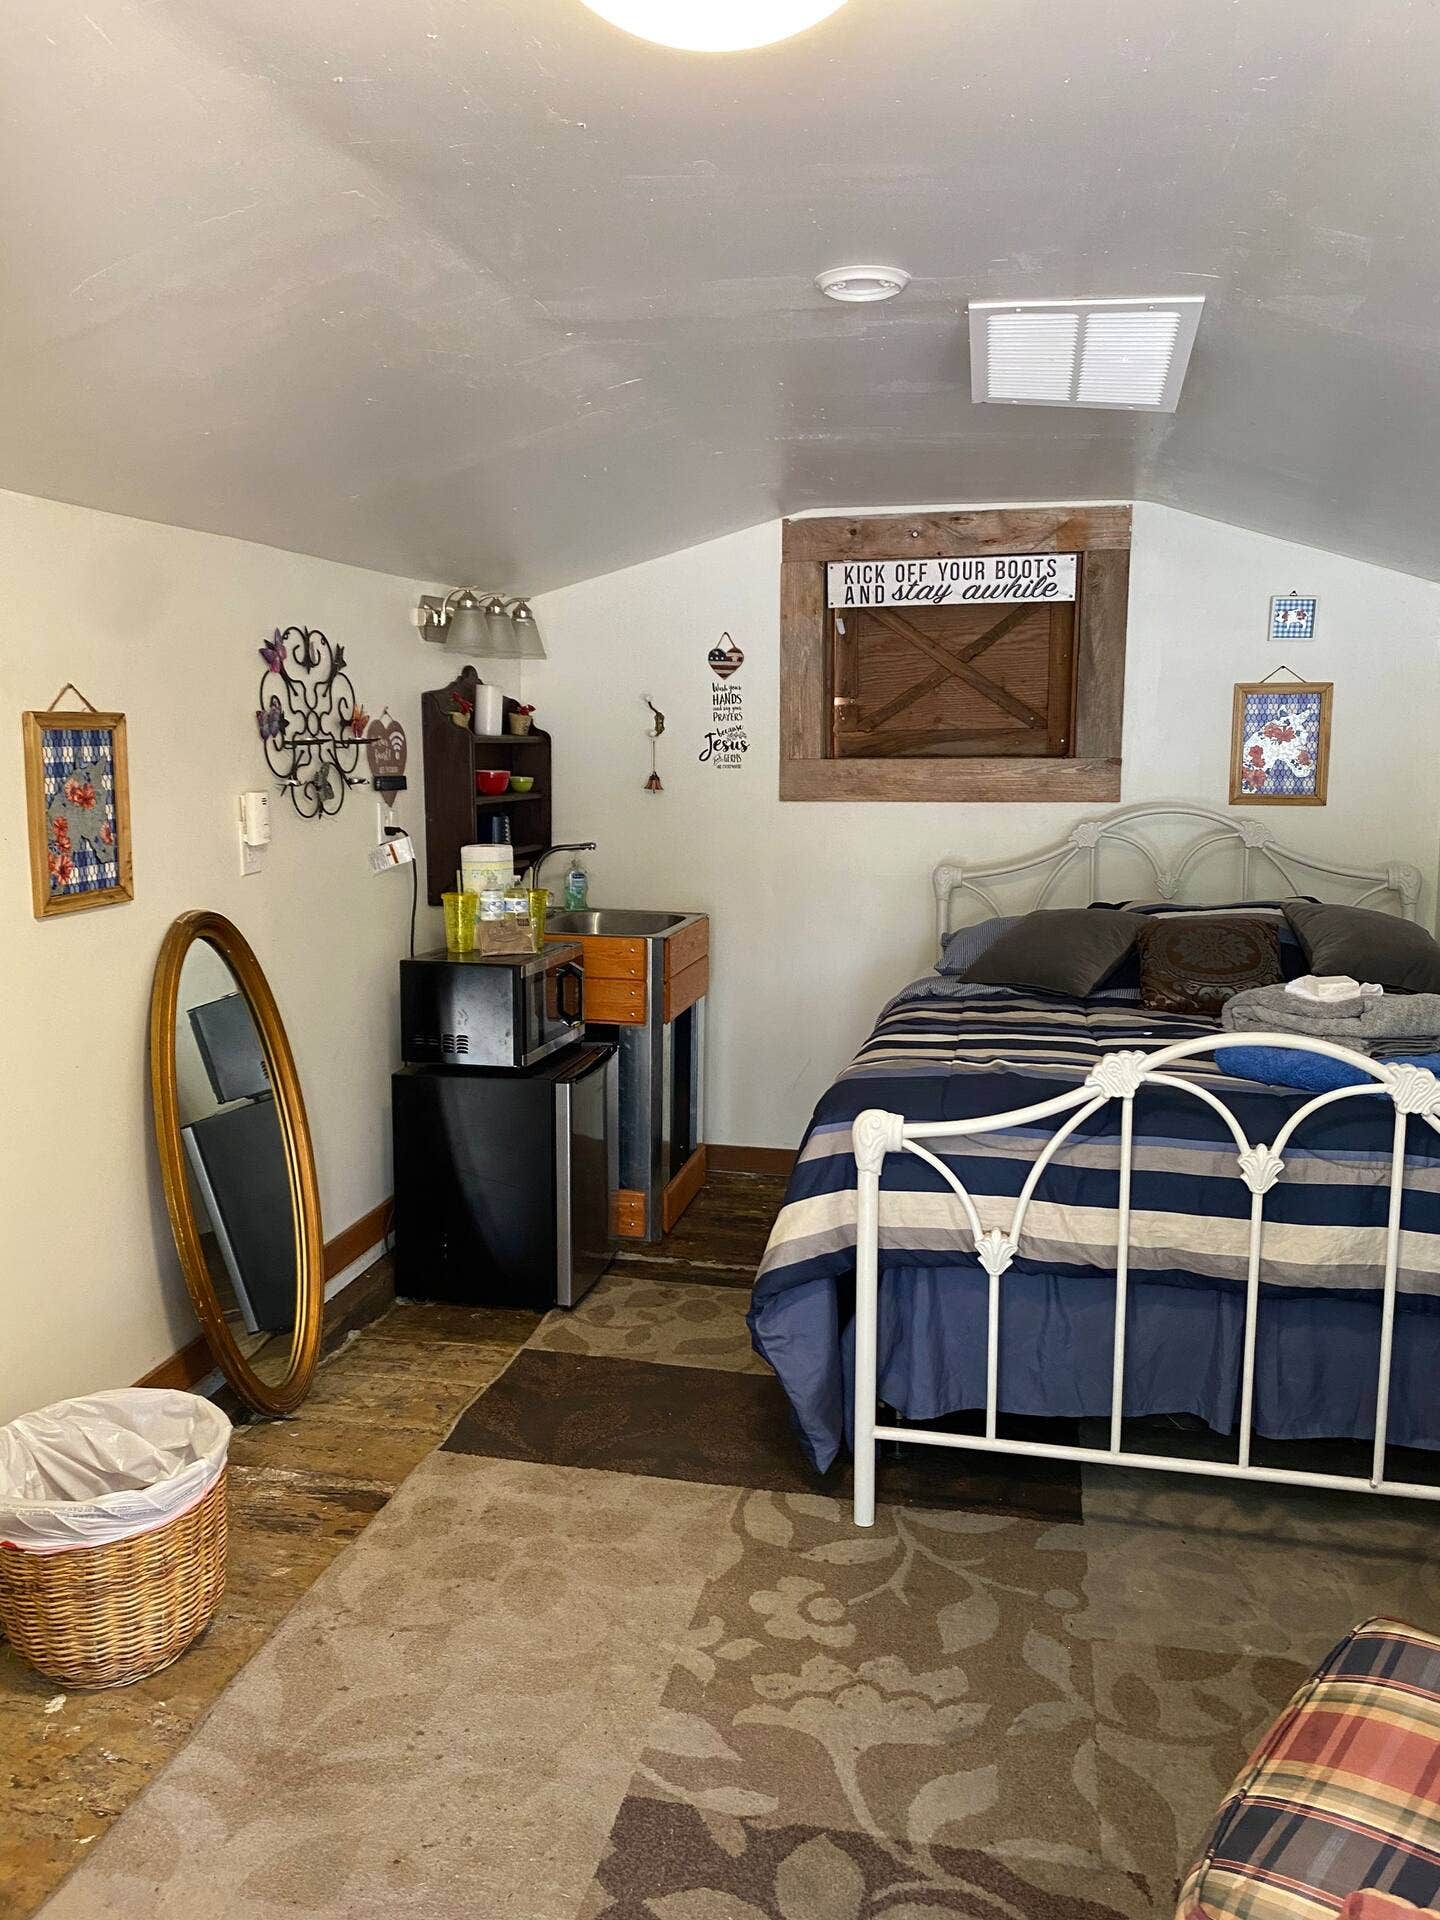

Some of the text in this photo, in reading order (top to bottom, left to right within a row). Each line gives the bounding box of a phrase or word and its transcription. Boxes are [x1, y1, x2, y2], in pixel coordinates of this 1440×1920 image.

[844, 558, 1058, 585] KICK OFF YOUR BOOTS
[844, 574, 1060, 605] AND stay awhile
[713, 693, 742, 705] HANDS
[713, 712, 743, 721] PRAYERS
[699, 733, 750, 761] Jesus
